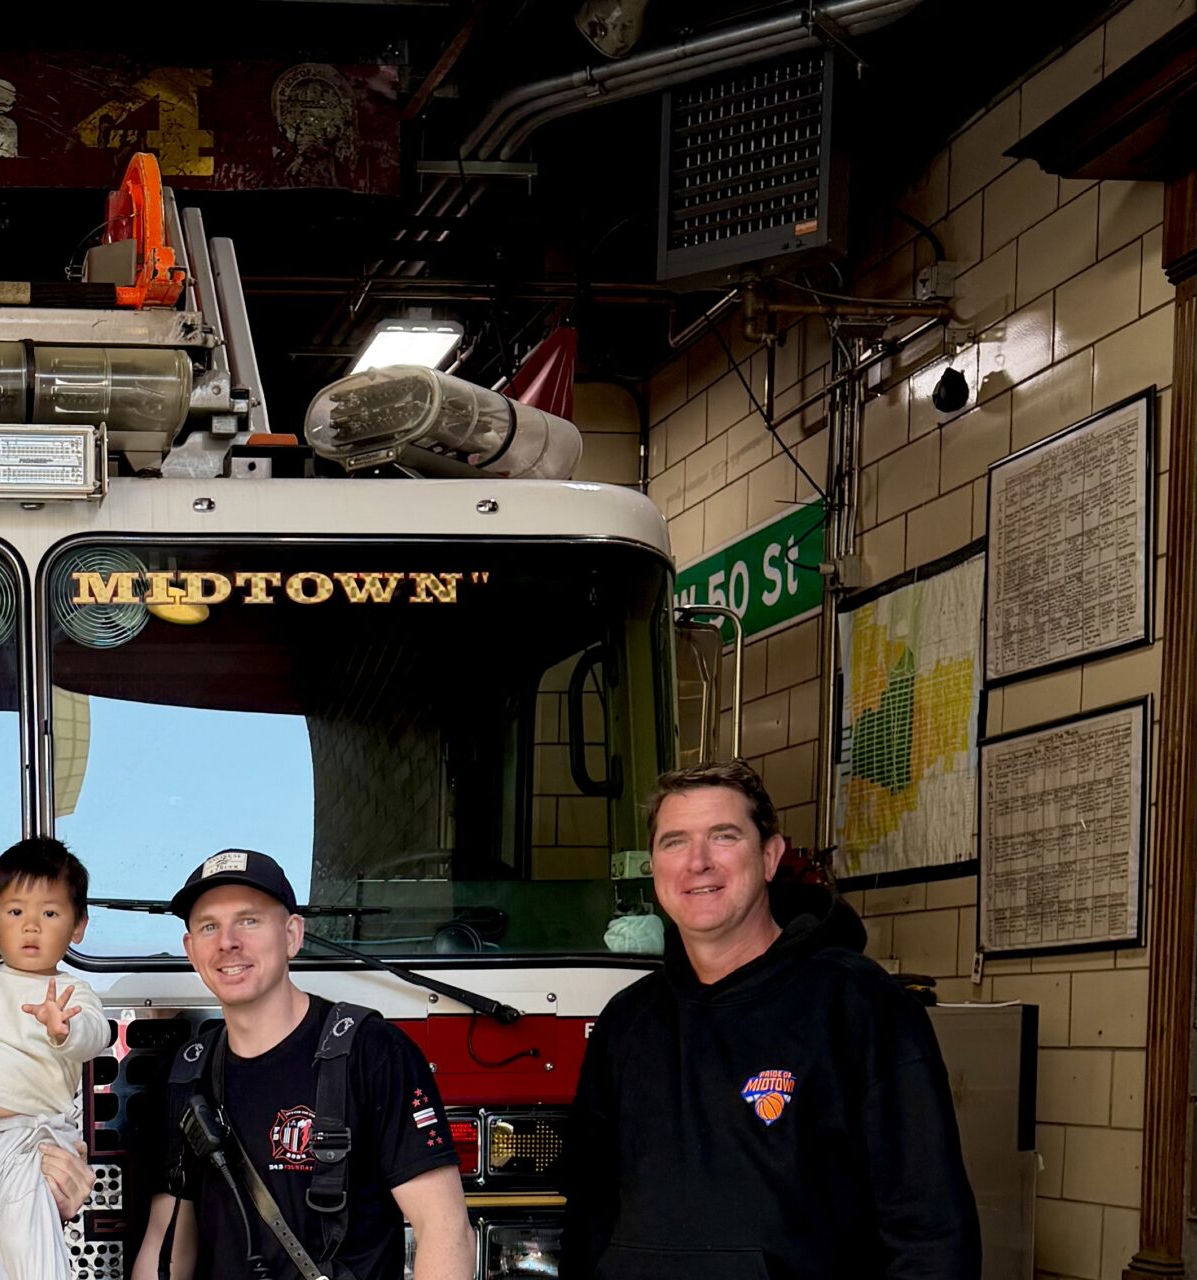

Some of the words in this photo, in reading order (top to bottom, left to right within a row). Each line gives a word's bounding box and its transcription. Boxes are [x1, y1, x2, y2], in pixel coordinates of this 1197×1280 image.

[77, 68, 214, 176] 4
[708, 560, 749, 629] 50
[762, 534, 799, 606] St
[759, 1070, 781, 1079] PRIDE
